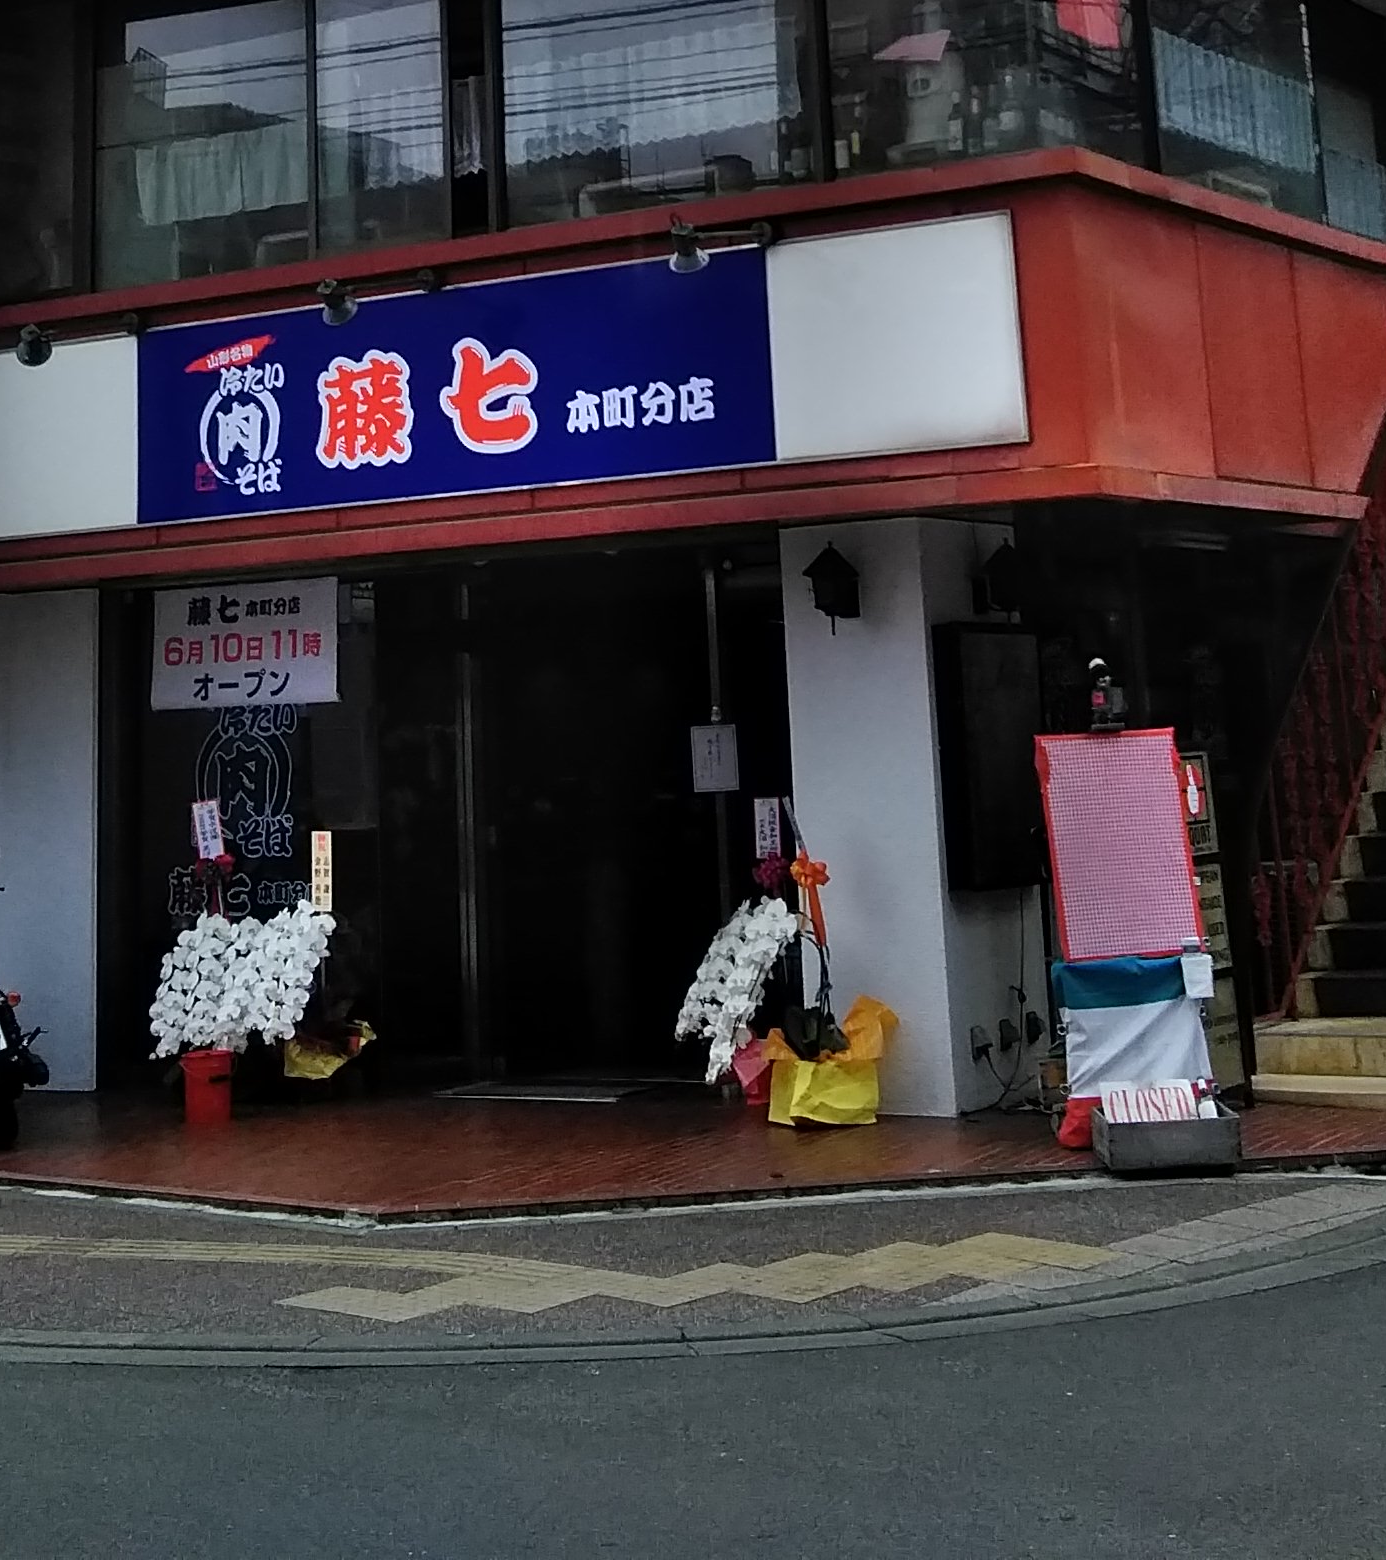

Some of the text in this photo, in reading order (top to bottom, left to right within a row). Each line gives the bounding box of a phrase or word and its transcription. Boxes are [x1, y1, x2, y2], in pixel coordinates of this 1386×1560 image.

[206, 344, 253, 369] 山形名物
[219, 363, 284, 396] 冷たい
[316, 336, 715, 470] 藤七 本町分店
[216, 401, 263, 465] 肉
[235, 458, 283, 495] そば
[187, 594, 301, 626] 藤七 本町分店
[164, 629, 321, 666] 6月10日11時
[193, 668, 290, 701] オープン
[236, 813, 293, 858] そば
[257, 880, 313, 906] 本町分
[1110, 1087, 1191, 1124] CLOSED
